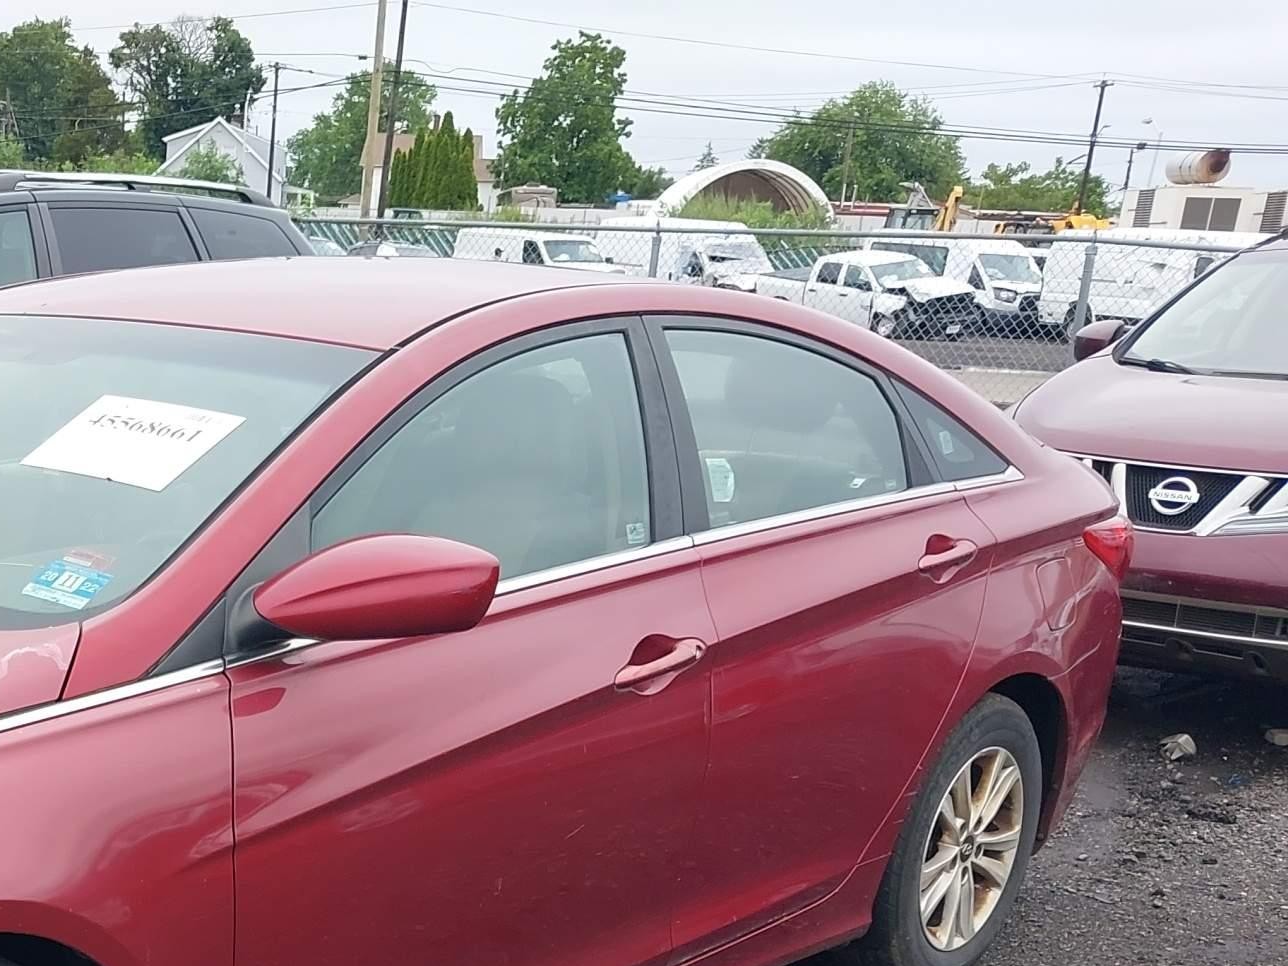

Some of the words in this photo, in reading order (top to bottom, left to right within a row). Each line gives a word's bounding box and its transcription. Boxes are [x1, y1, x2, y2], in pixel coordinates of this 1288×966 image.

[88, 413, 203, 442] 45568661
[1153, 491, 1193, 501] NISSAN
[40, 570, 59, 582] 20
[59, 574, 80, 589] 11
[79, 582, 100, 593] 22
